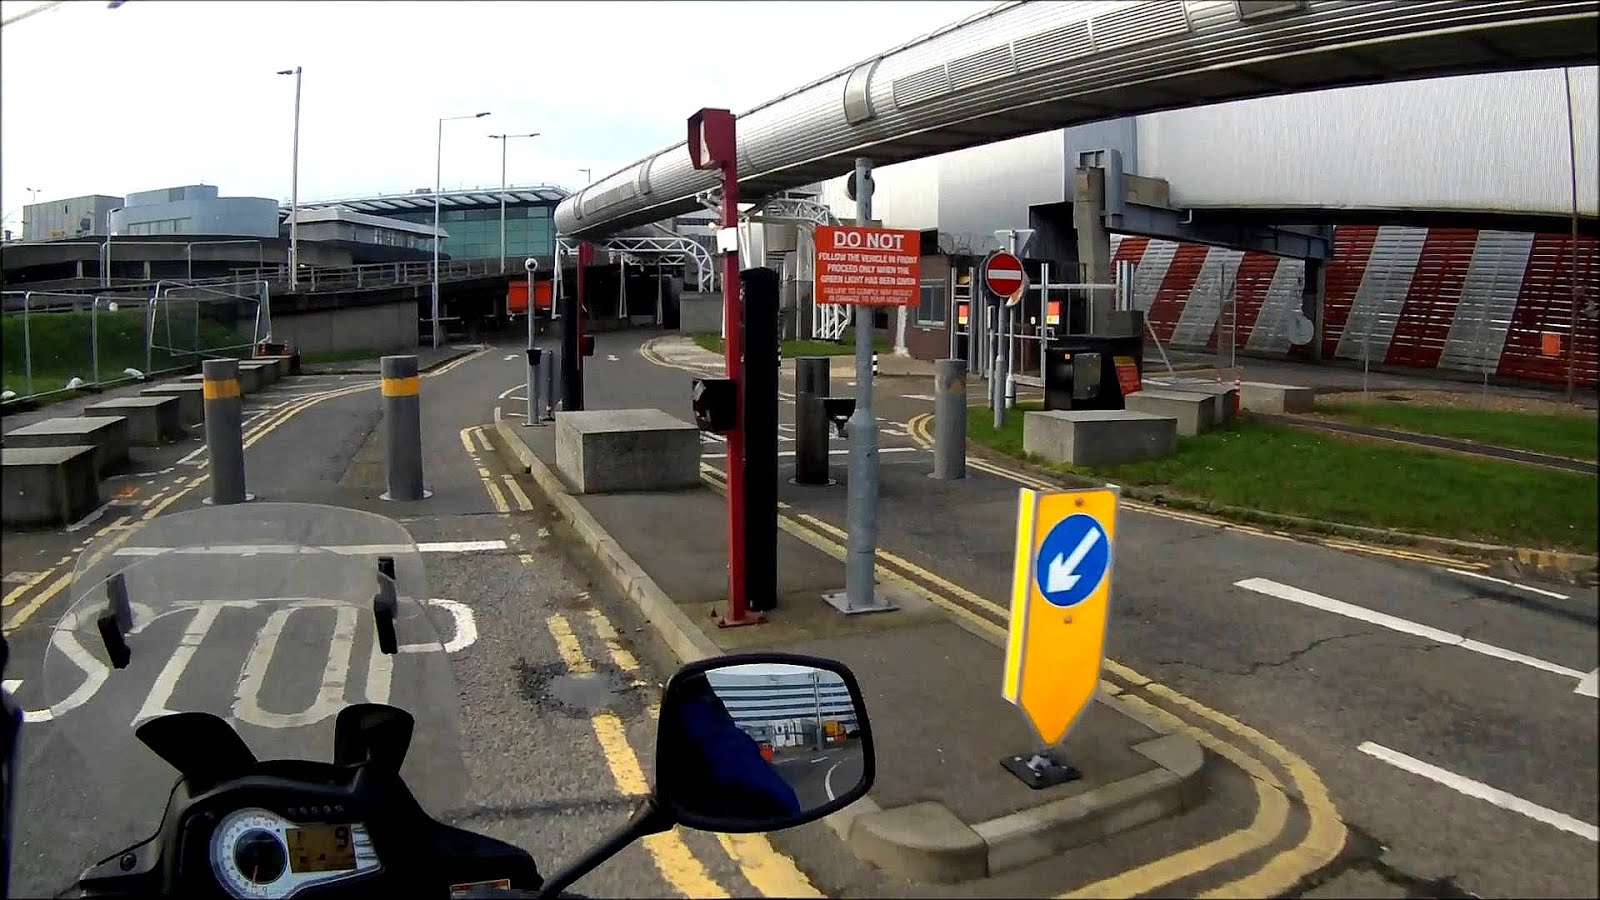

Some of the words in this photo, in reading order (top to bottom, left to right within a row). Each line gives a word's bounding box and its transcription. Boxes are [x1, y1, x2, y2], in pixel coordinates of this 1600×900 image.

[834, 231, 861, 247] DO
[867, 232, 905, 249] NOT
[818, 252, 846, 262] FOLLOW
[847, 253, 861, 262] THE
[861, 254, 888, 264] VEHICLE
[888, 255, 896, 263] IN
[897, 255, 918, 264] FRONT
[827, 264, 858, 273] PROCEED
[859, 265, 876, 273] ONLY
[876, 266, 896, 274] WHEN
[897, 266, 910, 275] THE
[820, 275, 843, 283] GREEN
[844, 275, 864, 284] LIGHT
[2, 597, 478, 729] STOP
